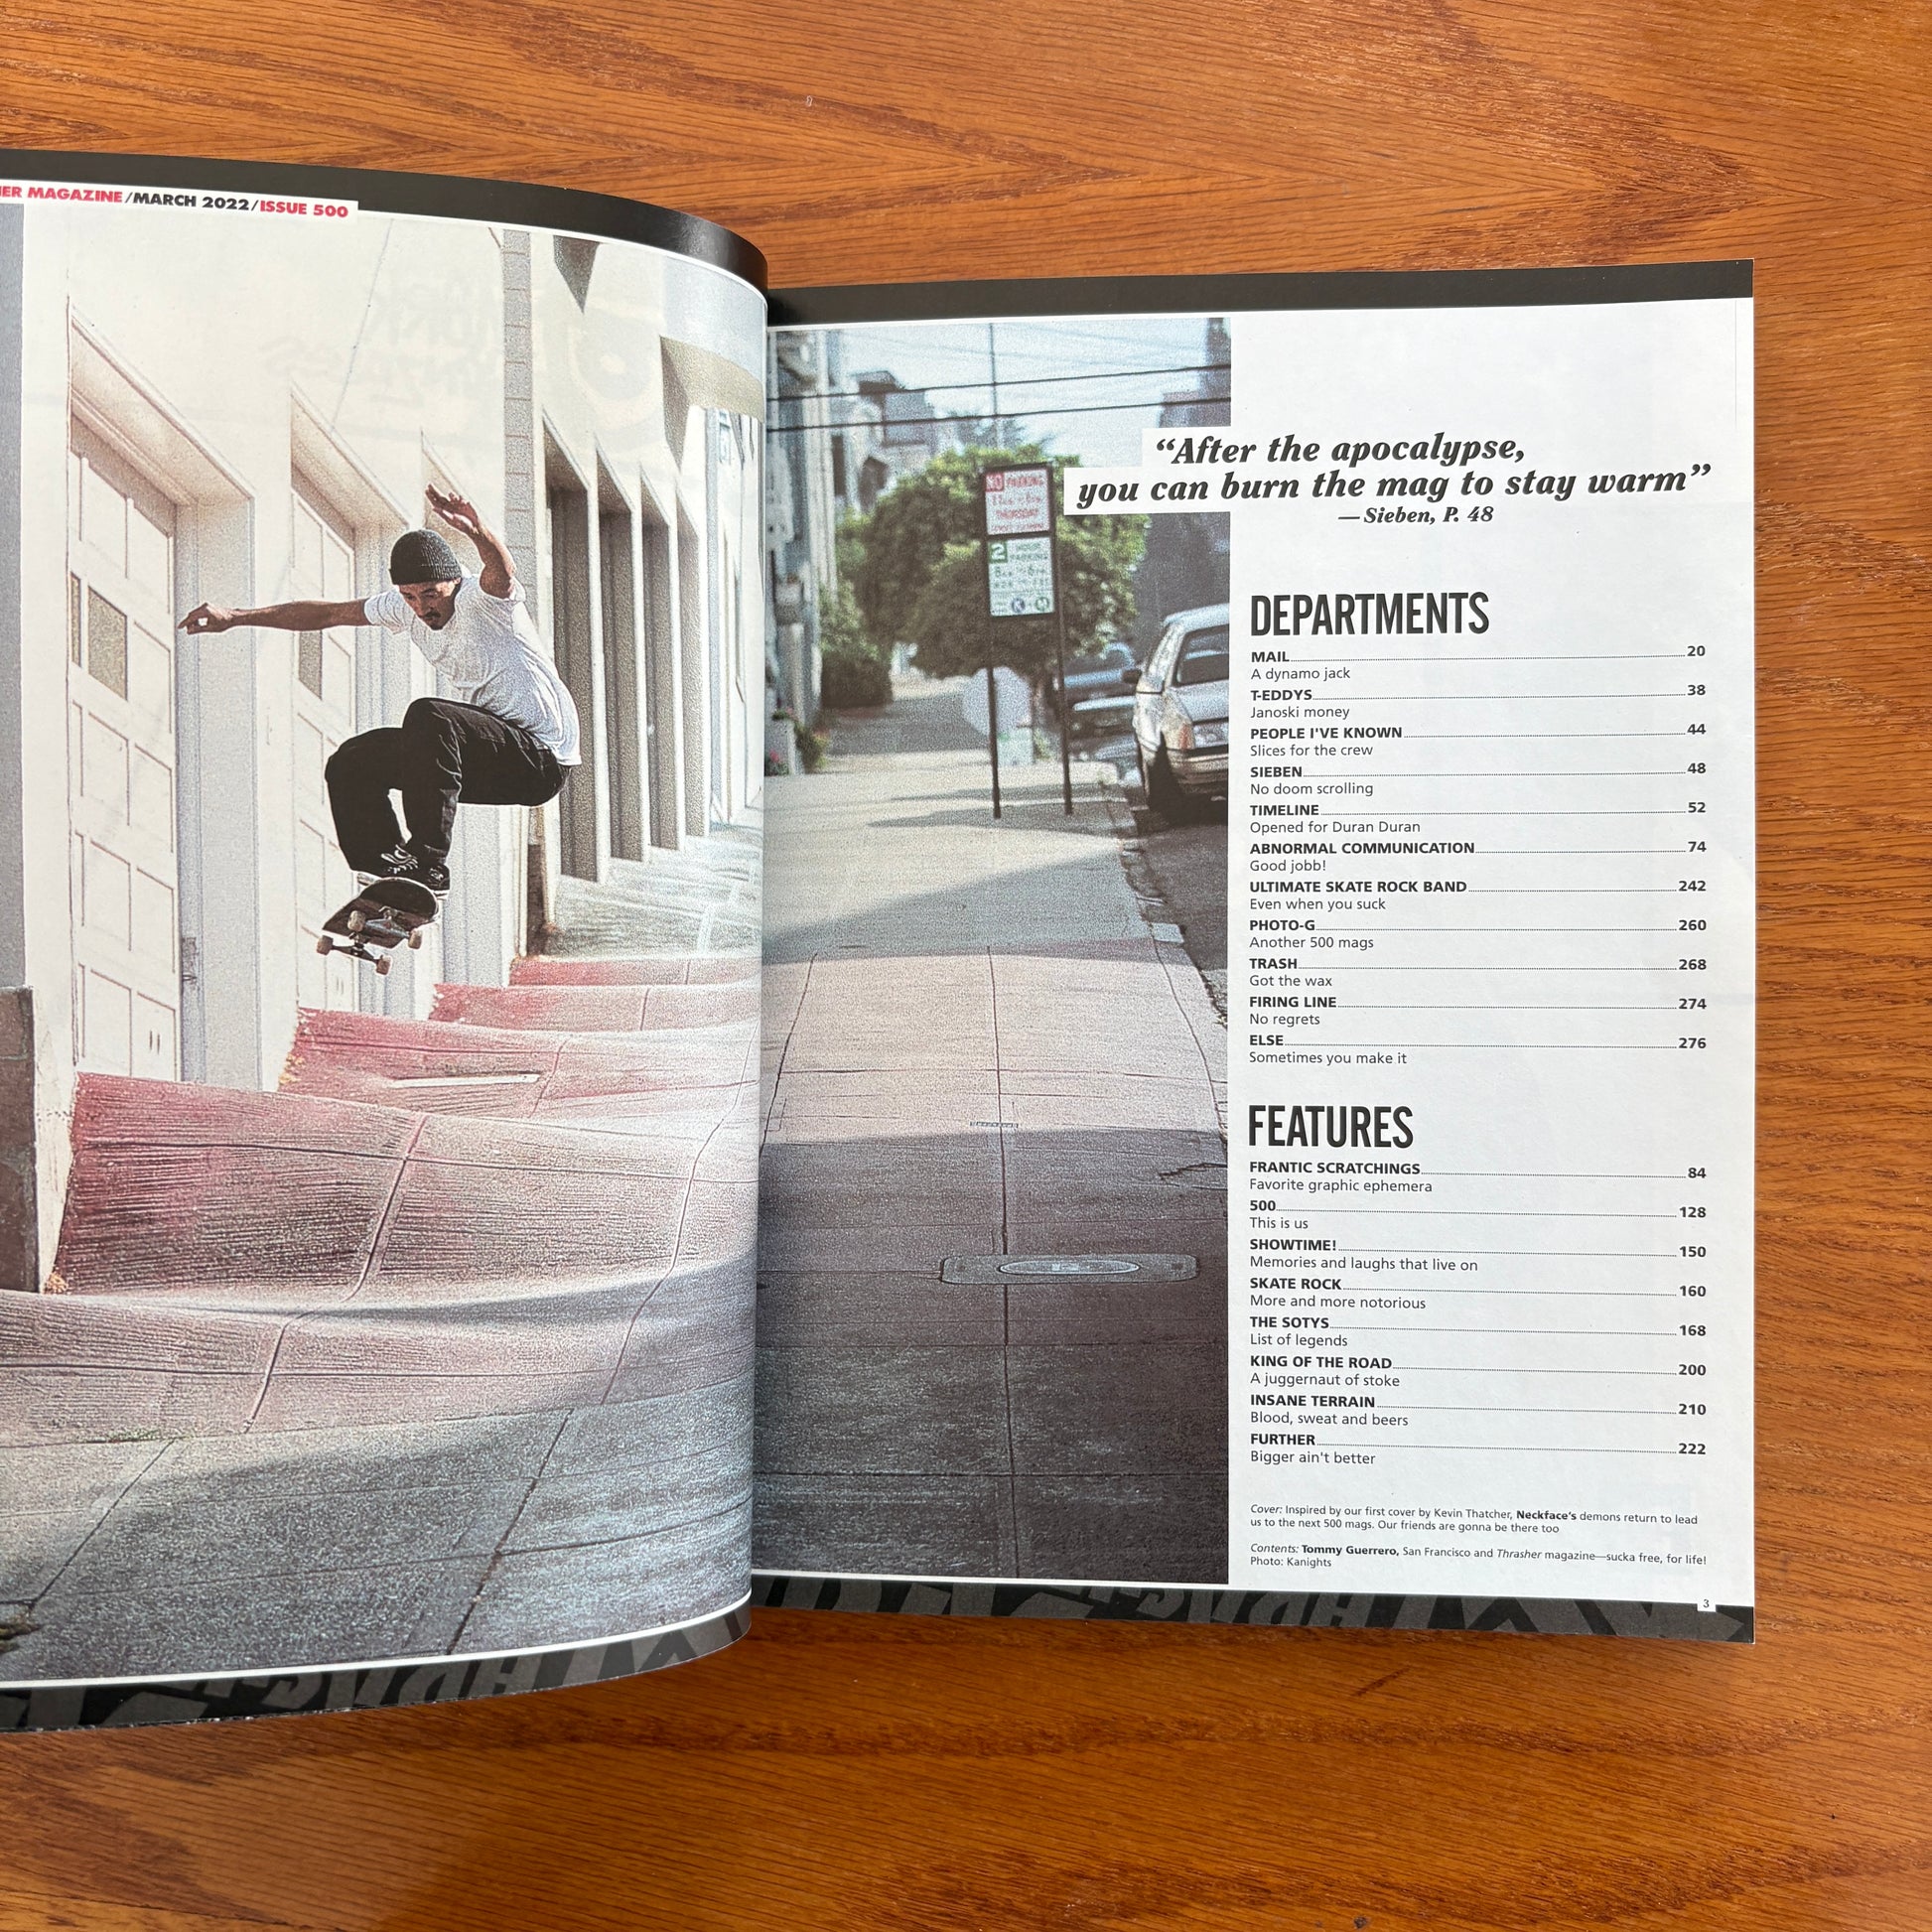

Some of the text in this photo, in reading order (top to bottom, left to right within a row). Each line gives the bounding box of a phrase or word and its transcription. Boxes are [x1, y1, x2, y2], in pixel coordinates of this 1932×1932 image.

[0, 186, 22, 198] ER
[314, 205, 348, 217] 500
[1267, 434, 1320, 463] the
[1331, 432, 1524, 468] apocalypse,
[1076, 483, 1139, 509] you
[1151, 482, 1208, 500] can
[1221, 471, 1299, 499] burn
[1312, 469, 1365, 497] the
[1376, 478, 1449, 503] mag
[1460, 471, 1493, 495] to
[1505, 470, 1577, 501] stay
[1443, 506, 1458, 522] P.
[1467, 506, 1494, 522] 48
[991, 543, 1006, 560] 2
[1251, 592, 1489, 636] DEPARTMENTS
[1252, 645, 1706, 662] MAIL 20
[1251, 667, 1350, 682] A dynamo jack
[1250, 684, 1706, 701] T-EDDYS 38
[1250, 706, 1350, 720] Janoski money
[1251, 728, 1305, 740] PEOPLE
[1343, 727, 1402, 739] KNOWN
[1687, 724, 1707, 735] 44
[1250, 762, 1706, 777] SIEBEN 48
[1251, 782, 1373, 797] No doom scrolling
[1250, 802, 1706, 816] TIMELINE 52
[1250, 841, 1707, 854] ABNORMAL COMMUNICATION 74
[1250, 859, 1325, 874] Good jobb!
[1250, 881, 1706, 893] ULTIMATE SKATE ROCK BAND 242
[1250, 919, 1707, 931] PHOTO-G 260
[1249, 936, 1374, 951] Another 500 mags
[1249, 958, 1707, 970] TRASH 268
[1250, 997, 1707, 1010] FIRING LINE 274
[1250, 1014, 1320, 1028] No regrets
[1250, 1035, 1707, 1048] ELSE 276
[1249, 1105, 1414, 1149] FEATURES
[1250, 1162, 1707, 1178] FRANTIC SCRATCHINGS 84
[1250, 1178, 1432, 1194] Favorite graphic ephemera
[1250, 1200, 1707, 1218] 500 128
[1250, 1239, 1707, 1257] SHOWTIME! 150
[1250, 1256, 1477, 1272] Memories and laughs that live on
[1250, 1278, 1706, 1297] SKATE ROCK 160
[1250, 1316, 1706, 1336] THE SOTYS 168
[1251, 1355, 1706, 1376] KING OF THE ROAD 200
[1251, 1394, 1707, 1415] INSANE TERRAIN 210
[1251, 1411, 1409, 1426] Blood, sweat and beers
[1251, 1434, 1706, 1454] FURTHER 222
[1251, 1504, 1283, 1514] Cover:
[1286, 1505, 1325, 1516] Inspired
[1329, 1506, 1341, 1517] by
[1365, 1506, 1385, 1516] first
[1419, 1508, 1431, 1519] by
[1435, 1508, 1462, 1517] Kevin
[1465, 1509, 1512, 1520] Thatcher,
[1580, 1511, 1620, 1522] demons
[1624, 1514, 1657, 1523] return
[1675, 1514, 1698, 1524] lead
[1278, 1518, 1295, 1527] the
[1324, 1519, 1342, 1528] 500
[1345, 1521, 1374, 1531] mags.
[1378, 1520, 1397, 1529] Our
[1401, 1520, 1436, 1530] friends
[1458, 1524, 1491, 1533] gonna
[1495, 1523, 1507, 1532] be
[1511, 1523, 1538, 1533] there
[1251, 1543, 1299, 1553] Contents:
[1302, 1545, 1342, 1557] Tommy
[1345, 1546, 1399, 1557] Guerrero,
[1403, 1547, 1421, 1556] San
[1425, 1547, 1470, 1557] Francisco
[1474, 1549, 1493, 1558] and
[1497, 1549, 1542, 1559] Thrasher
[1639, 1553, 1663, 1564] free,
[1667, 1554, 1682, 1564] for
[1686, 1555, 1706, 1565] life!
[1251, 1556, 1331, 1569] Photo: Kanights
[1703, 1598, 1710, 1608] 3
